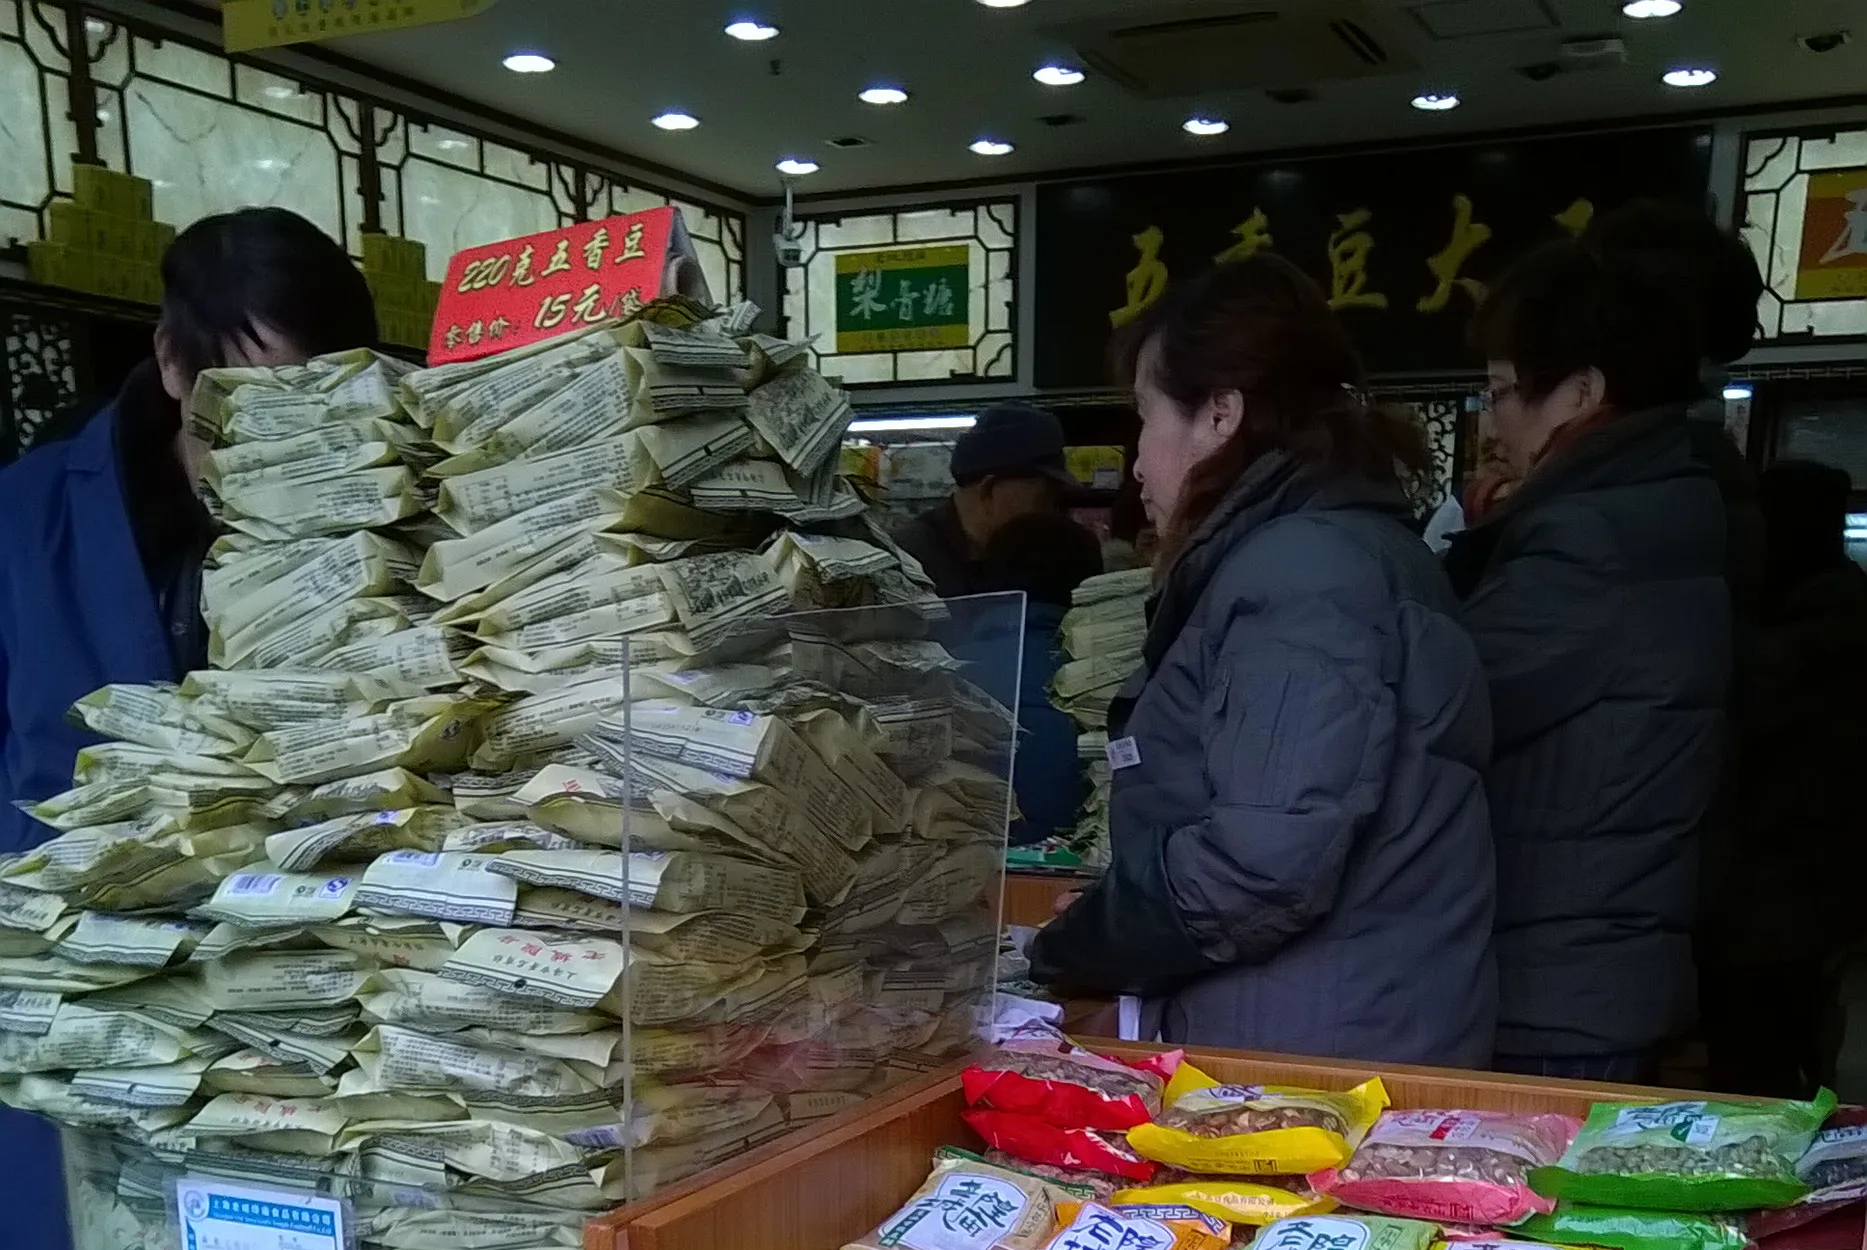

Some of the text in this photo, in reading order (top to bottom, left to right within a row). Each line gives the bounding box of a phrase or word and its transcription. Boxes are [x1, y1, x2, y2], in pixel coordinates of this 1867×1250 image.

[457, 222, 646, 295] 220克五香豆
[1109, 193, 1594, 328] 五豆大
